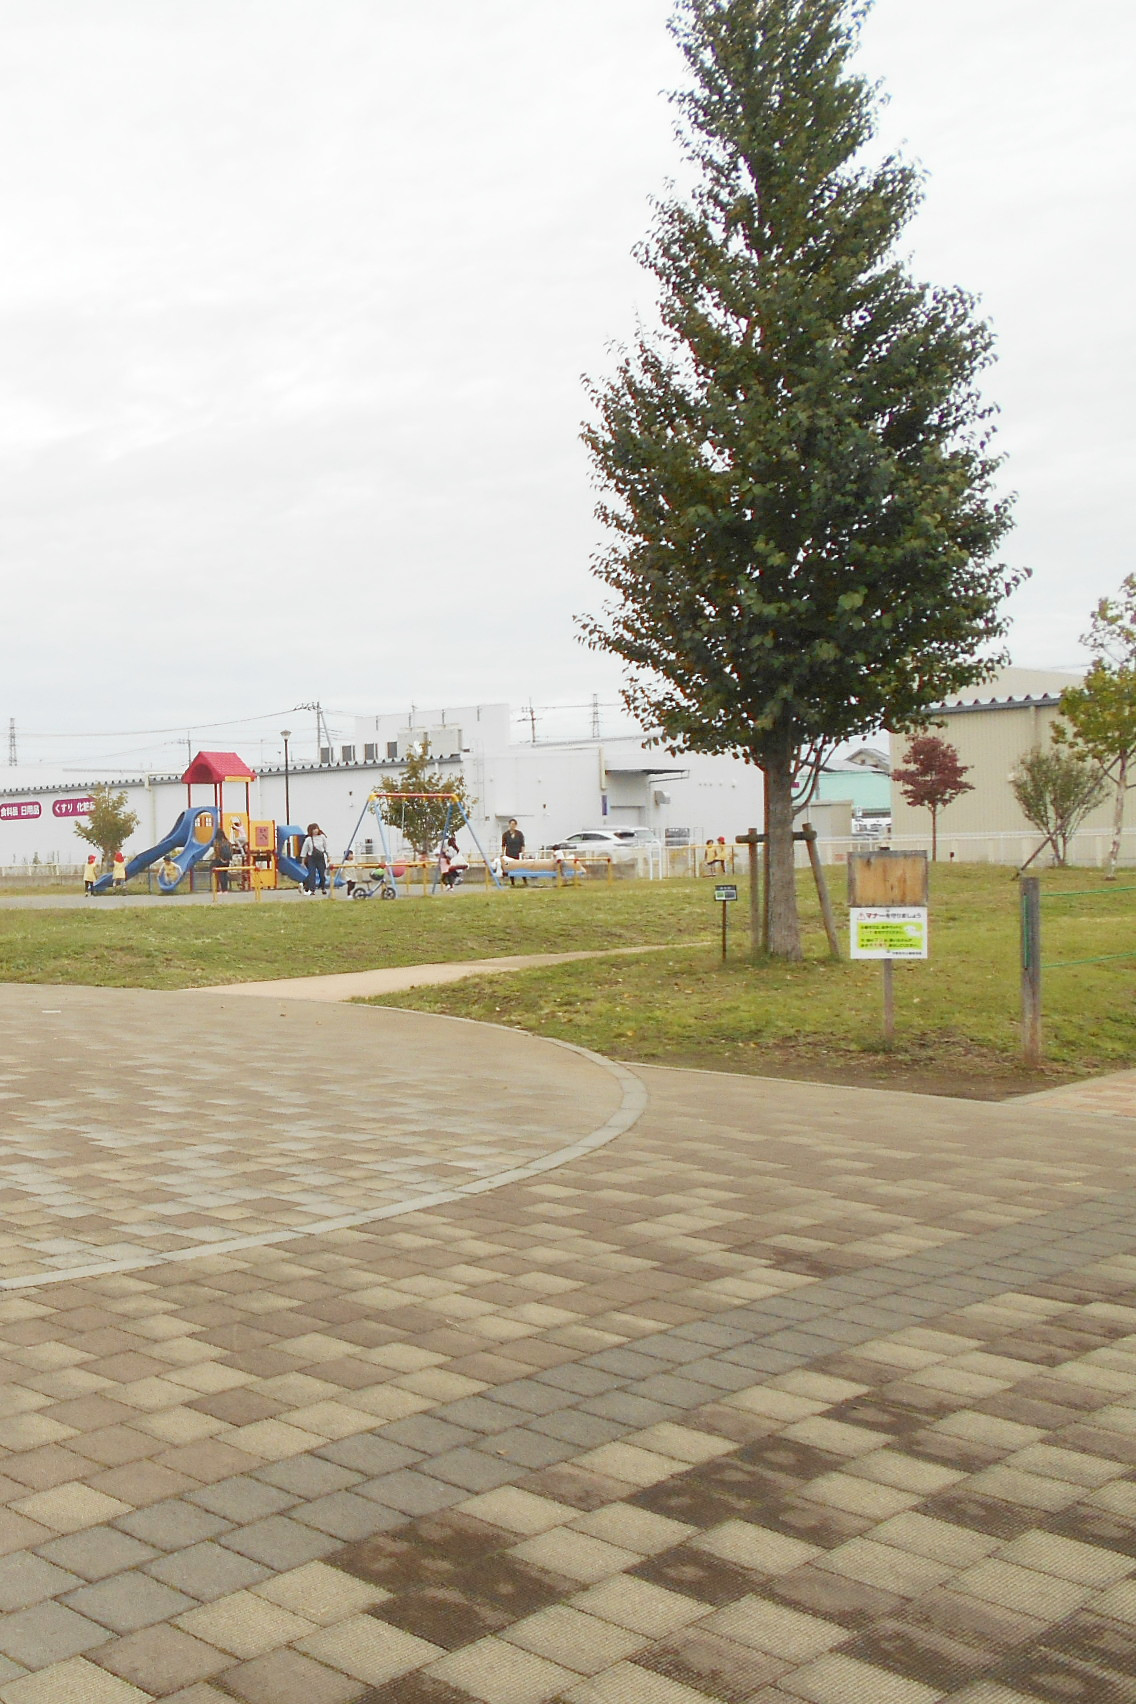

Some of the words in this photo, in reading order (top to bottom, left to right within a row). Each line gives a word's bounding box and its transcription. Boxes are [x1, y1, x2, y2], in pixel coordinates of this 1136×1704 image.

[0, 806, 19, 816] 食料品
[21, 804, 40, 815] 日用品
[55, 802, 73, 813] くすり
